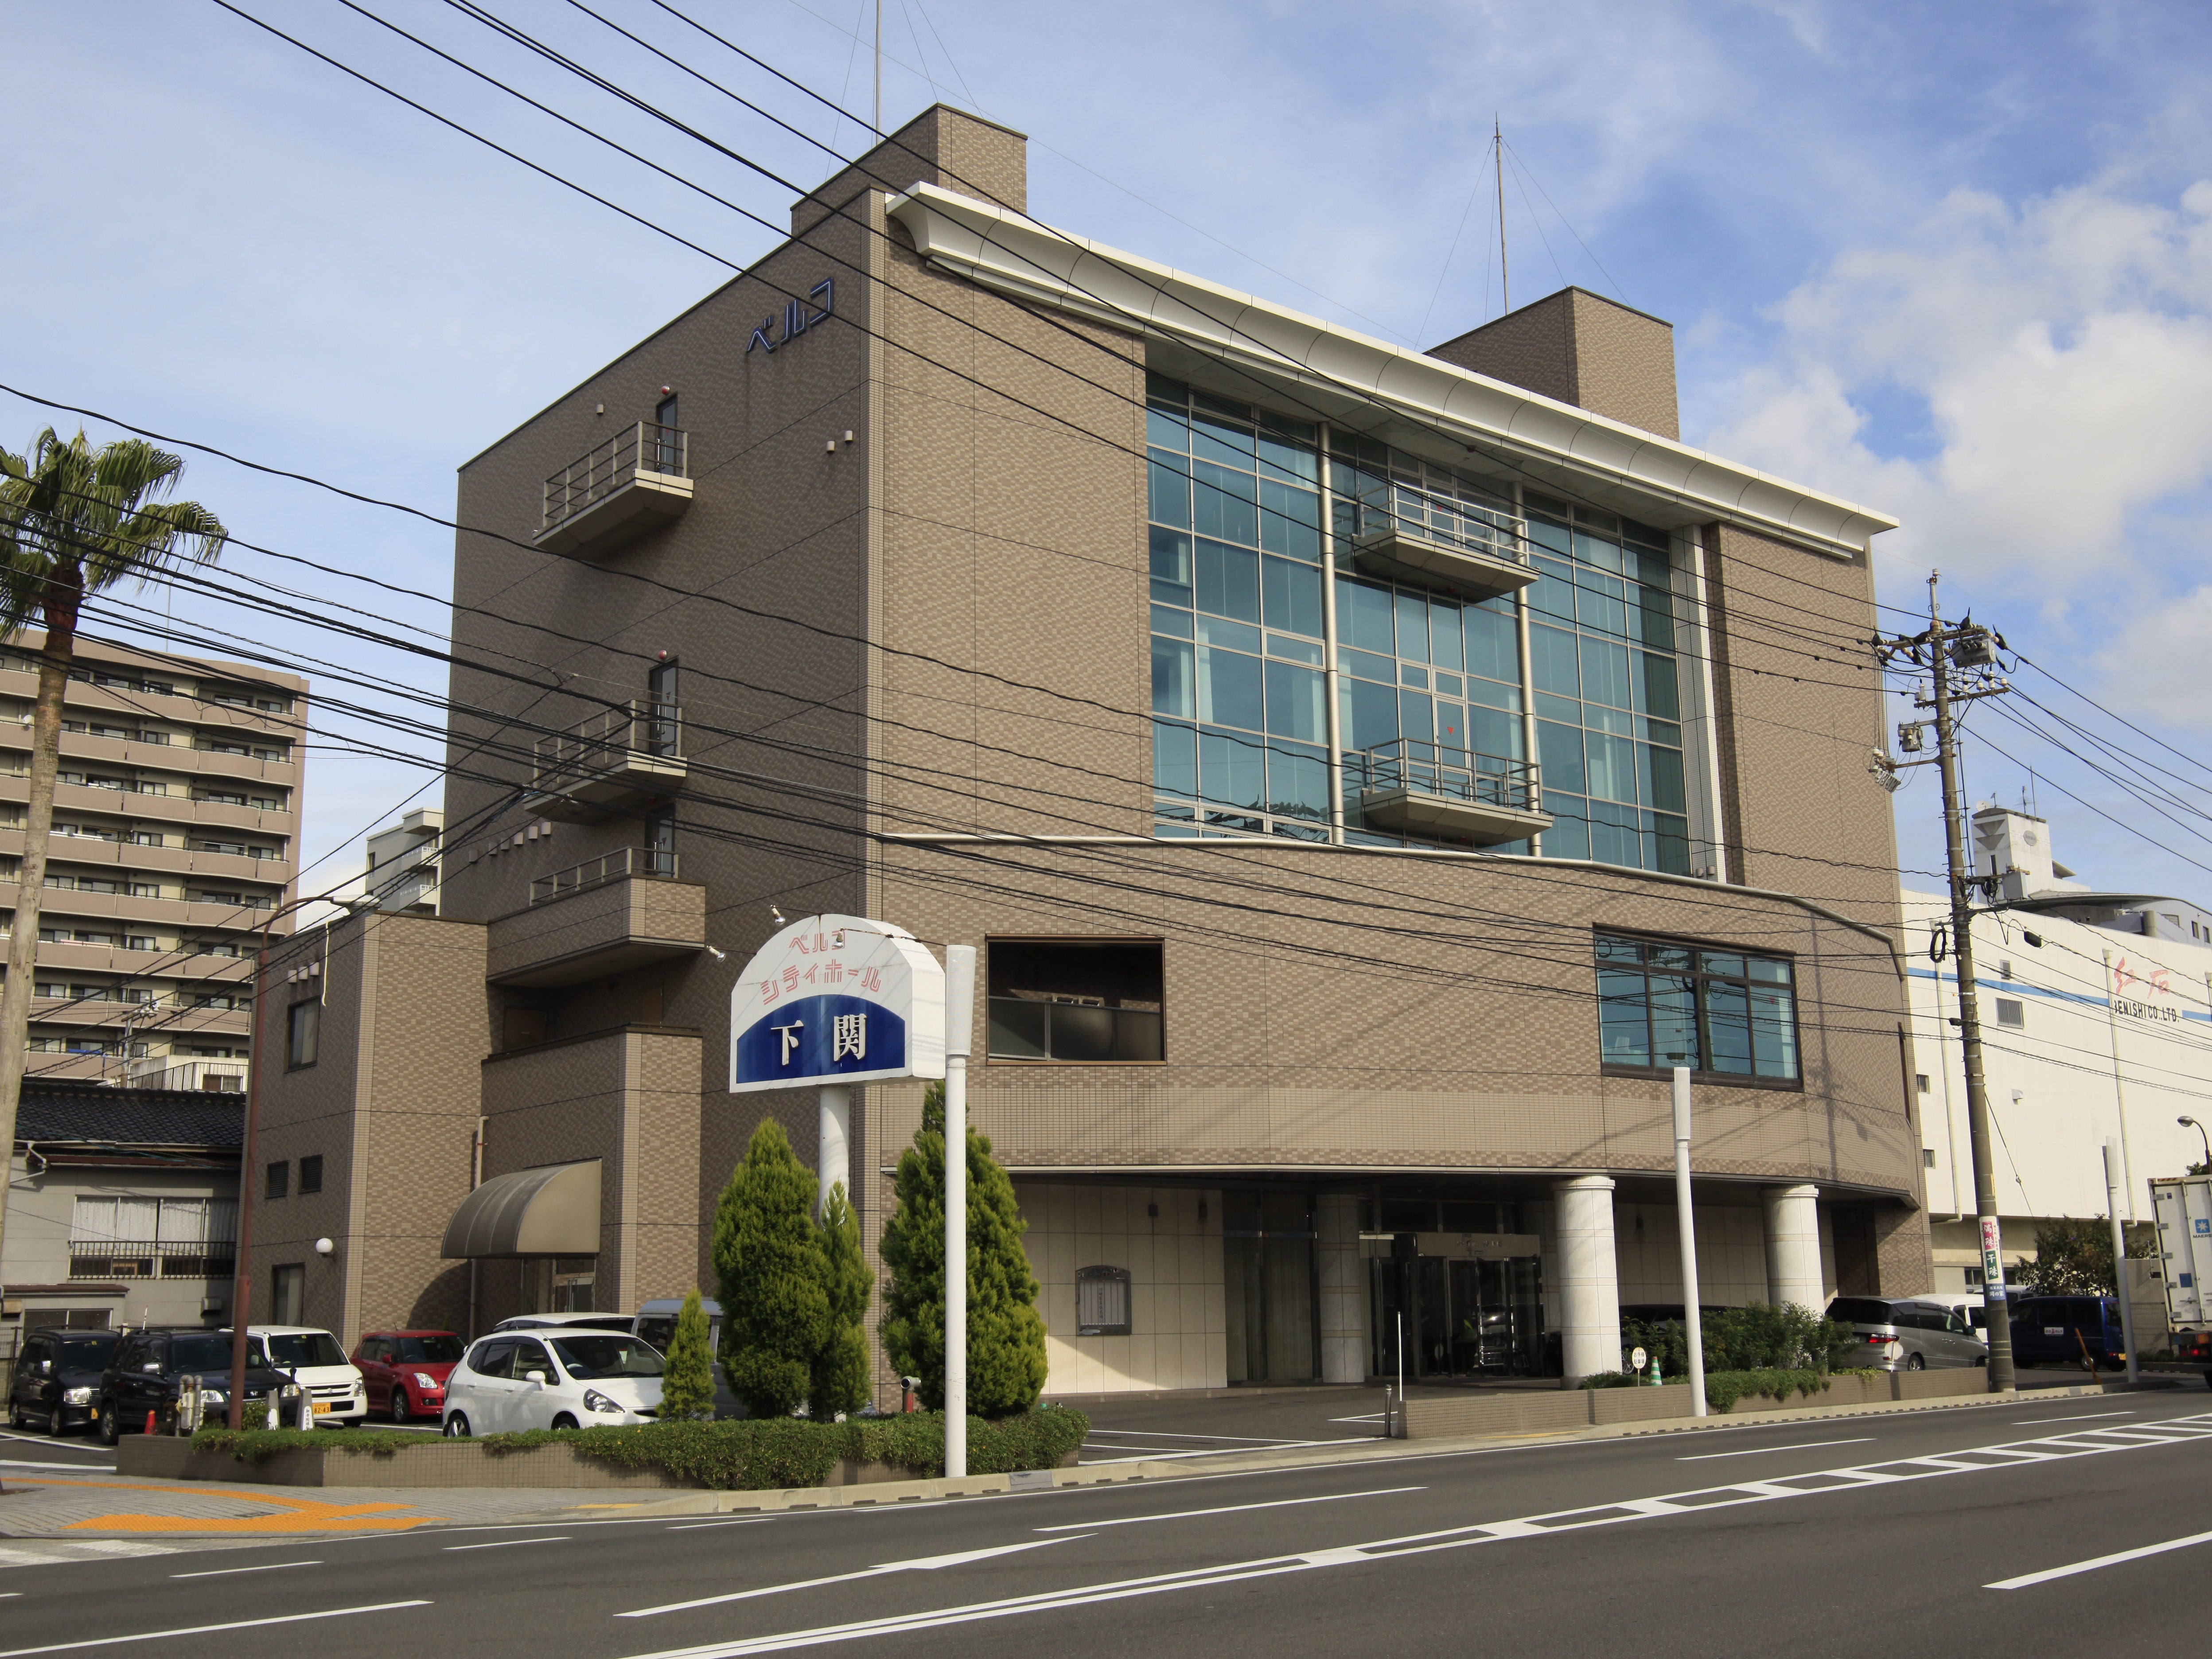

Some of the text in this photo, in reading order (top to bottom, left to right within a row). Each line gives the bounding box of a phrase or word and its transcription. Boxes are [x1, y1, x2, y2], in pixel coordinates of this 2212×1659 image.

[746, 277, 834, 354] ベルコ
[789, 930, 846, 954] ベルコ
[760, 958, 881, 1005] シティホール
[771, 1013, 867, 1066] 下関
